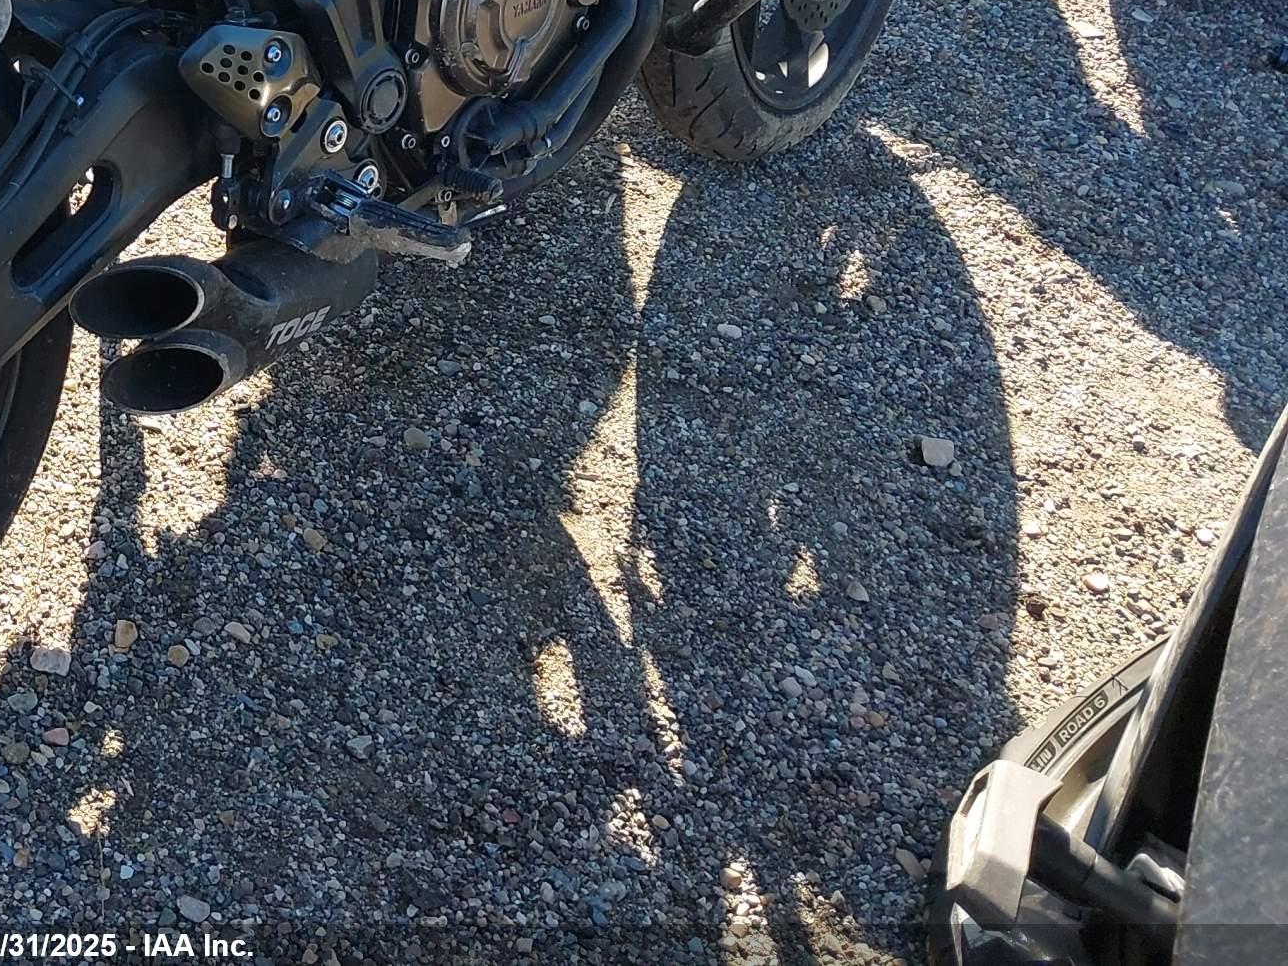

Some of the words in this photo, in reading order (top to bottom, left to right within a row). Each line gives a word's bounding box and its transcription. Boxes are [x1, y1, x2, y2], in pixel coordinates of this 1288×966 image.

[264, 305, 332, 351] TOCE
[1057, 705, 1096, 743] ROAD
[1093, 695, 1107, 710] 6
